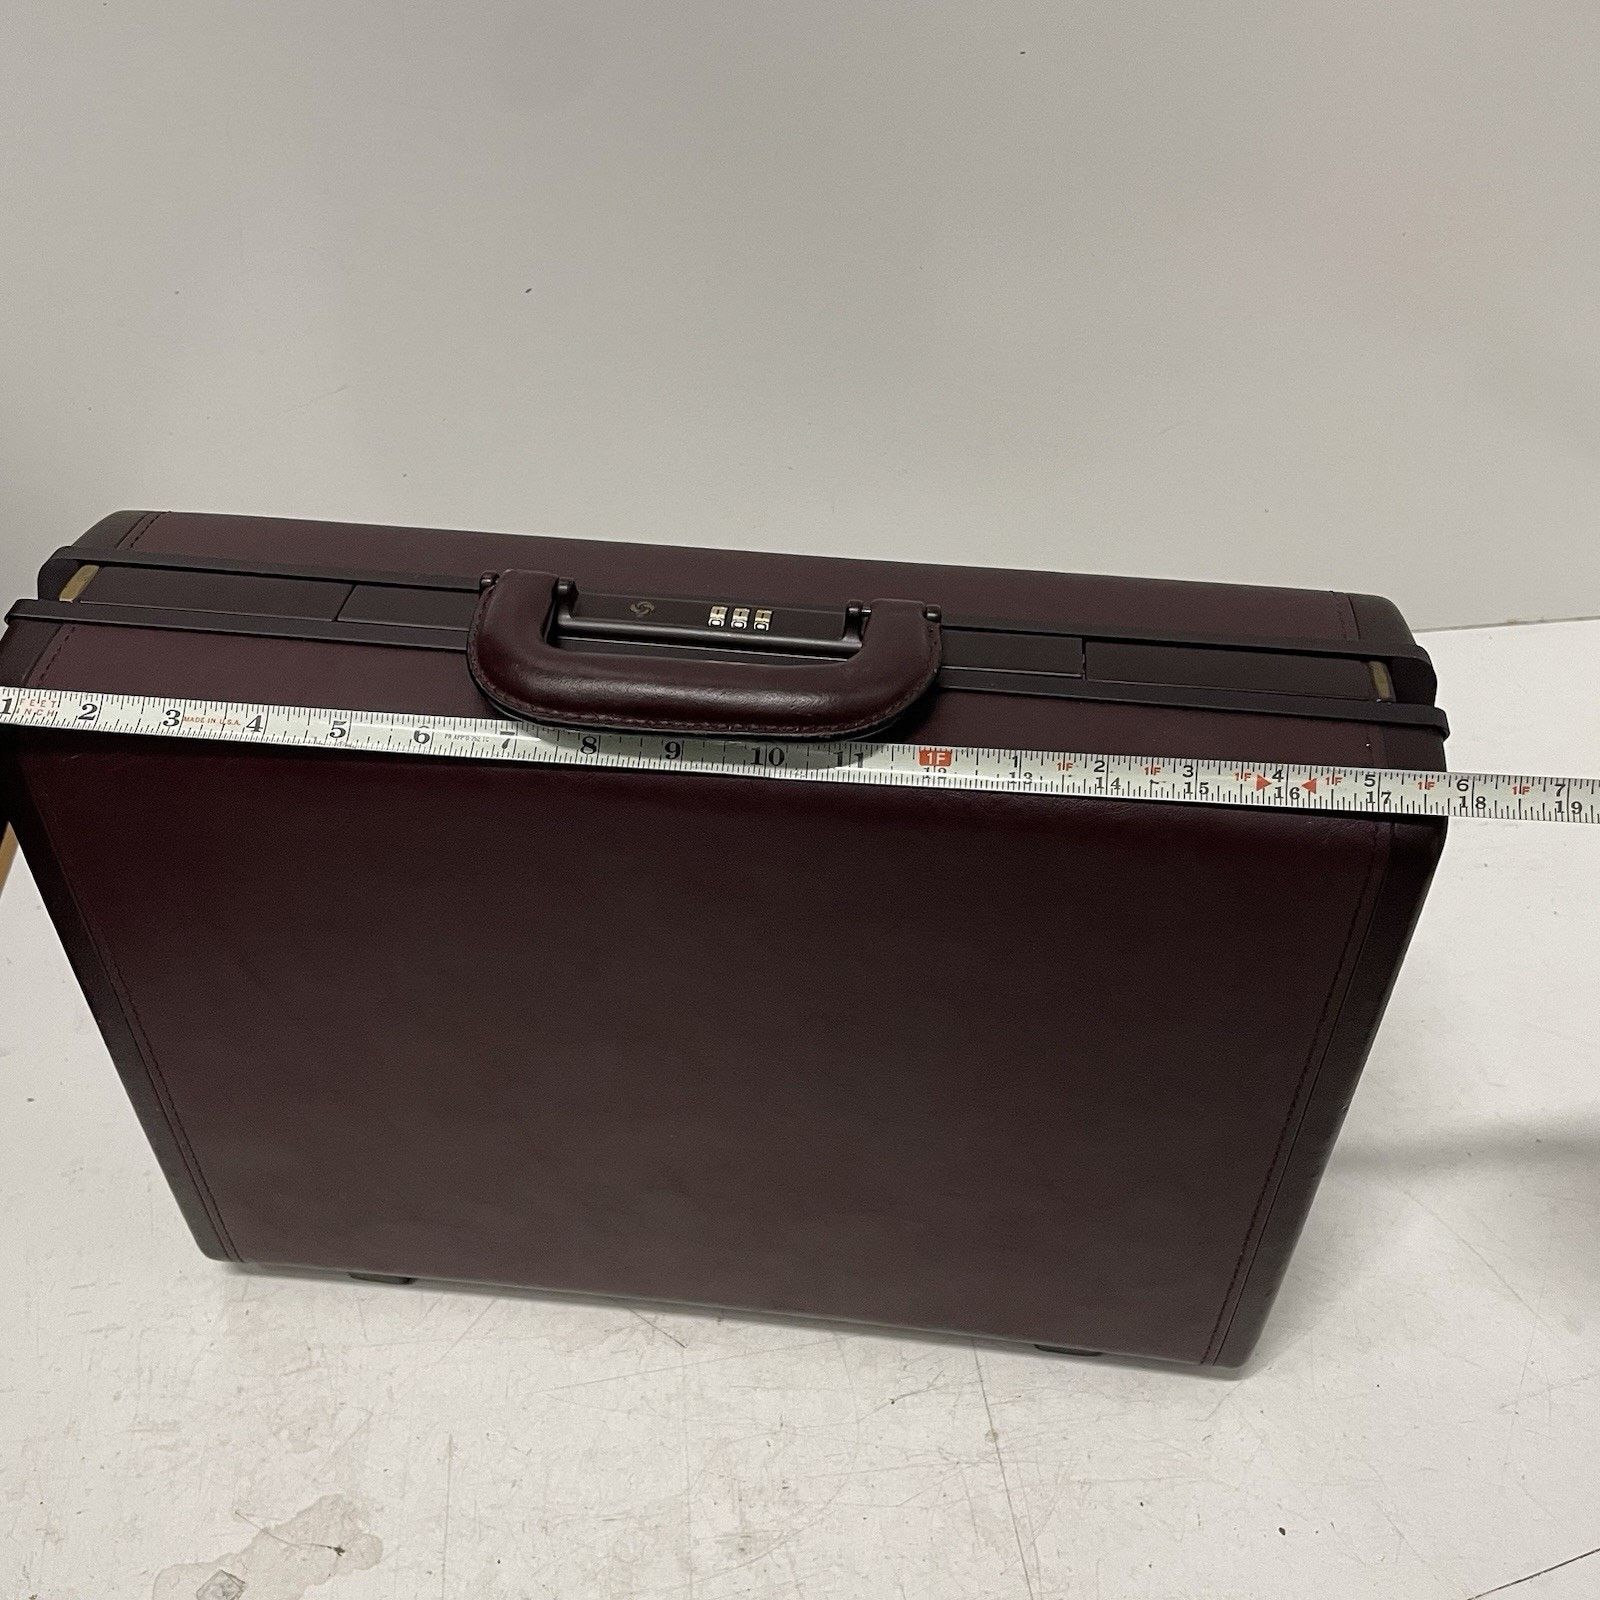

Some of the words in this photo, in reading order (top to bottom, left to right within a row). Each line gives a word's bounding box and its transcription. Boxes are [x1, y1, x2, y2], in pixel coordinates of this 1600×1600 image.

[20, 698, 57, 708] FEET
[16, 707, 55, 717] INCH
[78, 703, 98, 721] 2
[163, 709, 181, 727] 3
[246, 714, 264, 733] 4
[329, 720, 347, 739] 5
[413, 725, 431, 744] 6
[500, 730, 516, 750] 7
[580, 735, 598, 755] 8
[664, 741, 681, 759] 9
[750, 746, 785, 766] 10
[834, 751, 865, 768] 11
[926, 750, 946, 765] 1F
[1057, 762, 1074, 772] 1F
[1093, 760, 1106, 773] 2
[1144, 765, 1161, 776] 1F
[1182, 764, 1195, 778] 3
[1234, 771, 1252, 782] 1F
[1271, 769, 1284, 781] 4
[1325, 776, 1343, 786] 1F
[1364, 774, 1376, 788] 5
[1096, 776, 1122, 790] 14
[1184, 781, 1210, 795] 15
[1417, 781, 1435, 791] 1F
[1456, 778, 1469, 792] 6
[1554, 783, 1567, 797] 7
[1274, 786, 1301, 800] 16
[1366, 790, 1392, 805] 17
[1511, 785, 1531, 796] 1F
[1459, 795, 1487, 809] 18
[1554, 801, 1583, 815] 19
